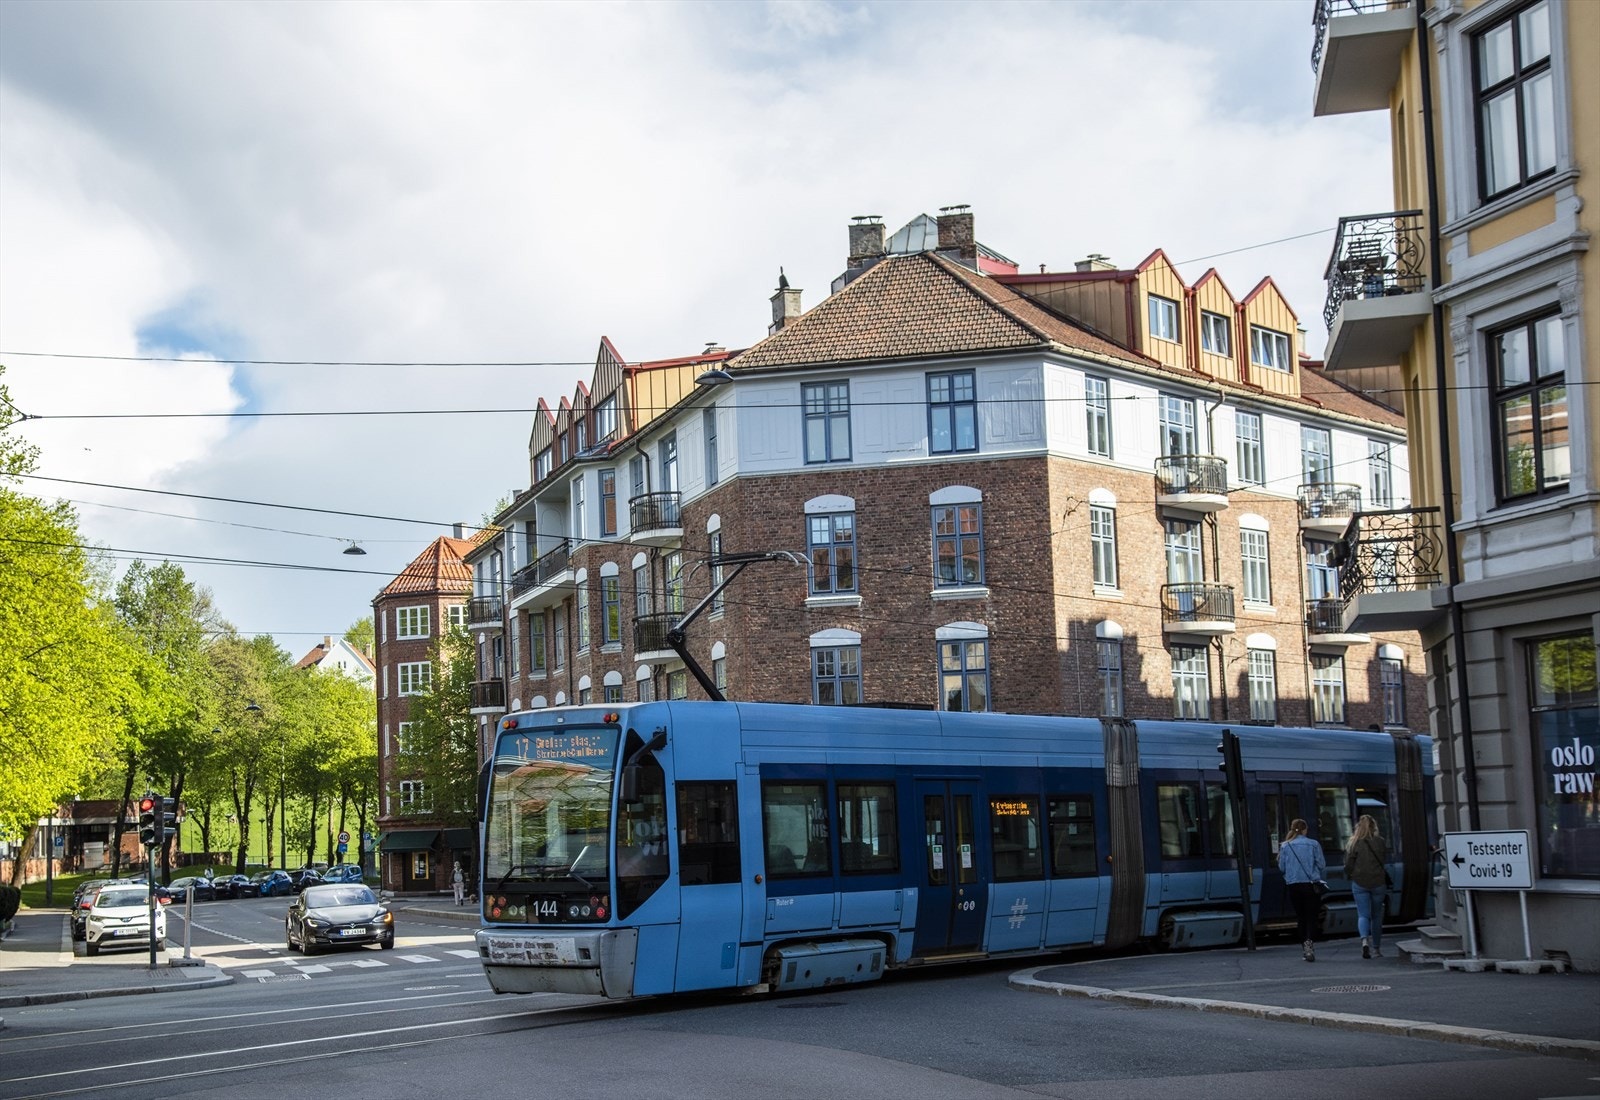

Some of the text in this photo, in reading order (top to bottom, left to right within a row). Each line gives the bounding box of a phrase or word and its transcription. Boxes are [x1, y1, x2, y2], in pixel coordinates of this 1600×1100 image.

[516, 738, 529, 761] 17
[1551, 737, 1595, 767] oslo
[1552, 772, 1596, 794] raw
[56, 837, 62, 846] P
[1467, 841, 1523, 856] Testsenter
[1469, 863, 1513, 878] Covid-19
[533, 900, 558, 917] 144
